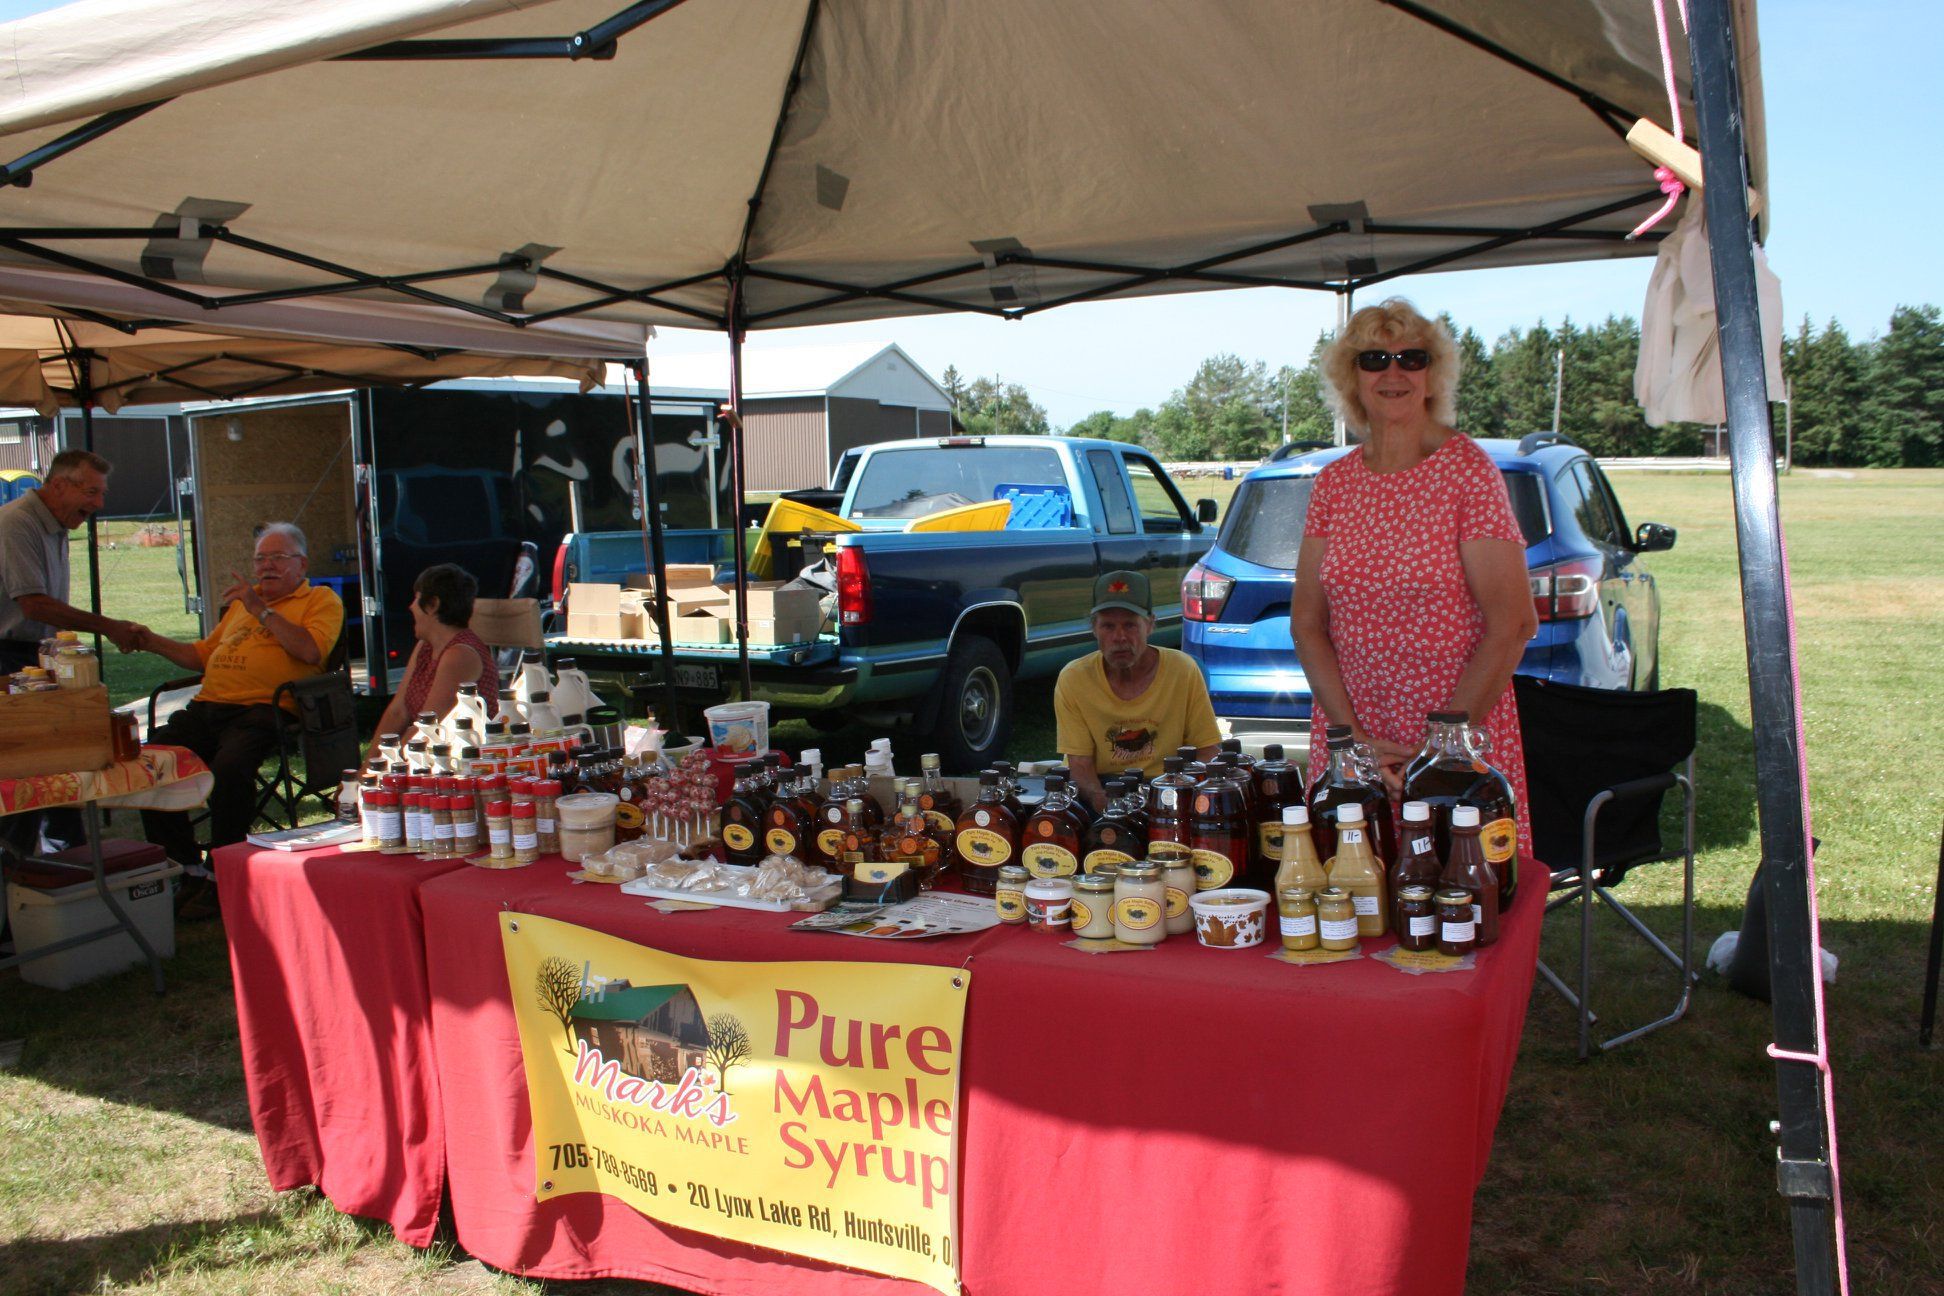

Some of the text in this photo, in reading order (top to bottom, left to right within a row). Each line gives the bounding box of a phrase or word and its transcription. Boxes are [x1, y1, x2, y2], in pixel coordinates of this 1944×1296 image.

[774, 988, 953, 1076] Pure
[573, 1039, 739, 1127] Mark's
[575, 1090, 750, 1155] MUSKOKA MAPLE
[773, 1068, 952, 1141] Maple
[549, 1142, 954, 1269] 705-789-8569 20 Lynx Lake Rd, Huntsville, O
[779, 1121, 950, 1210] Syrup
